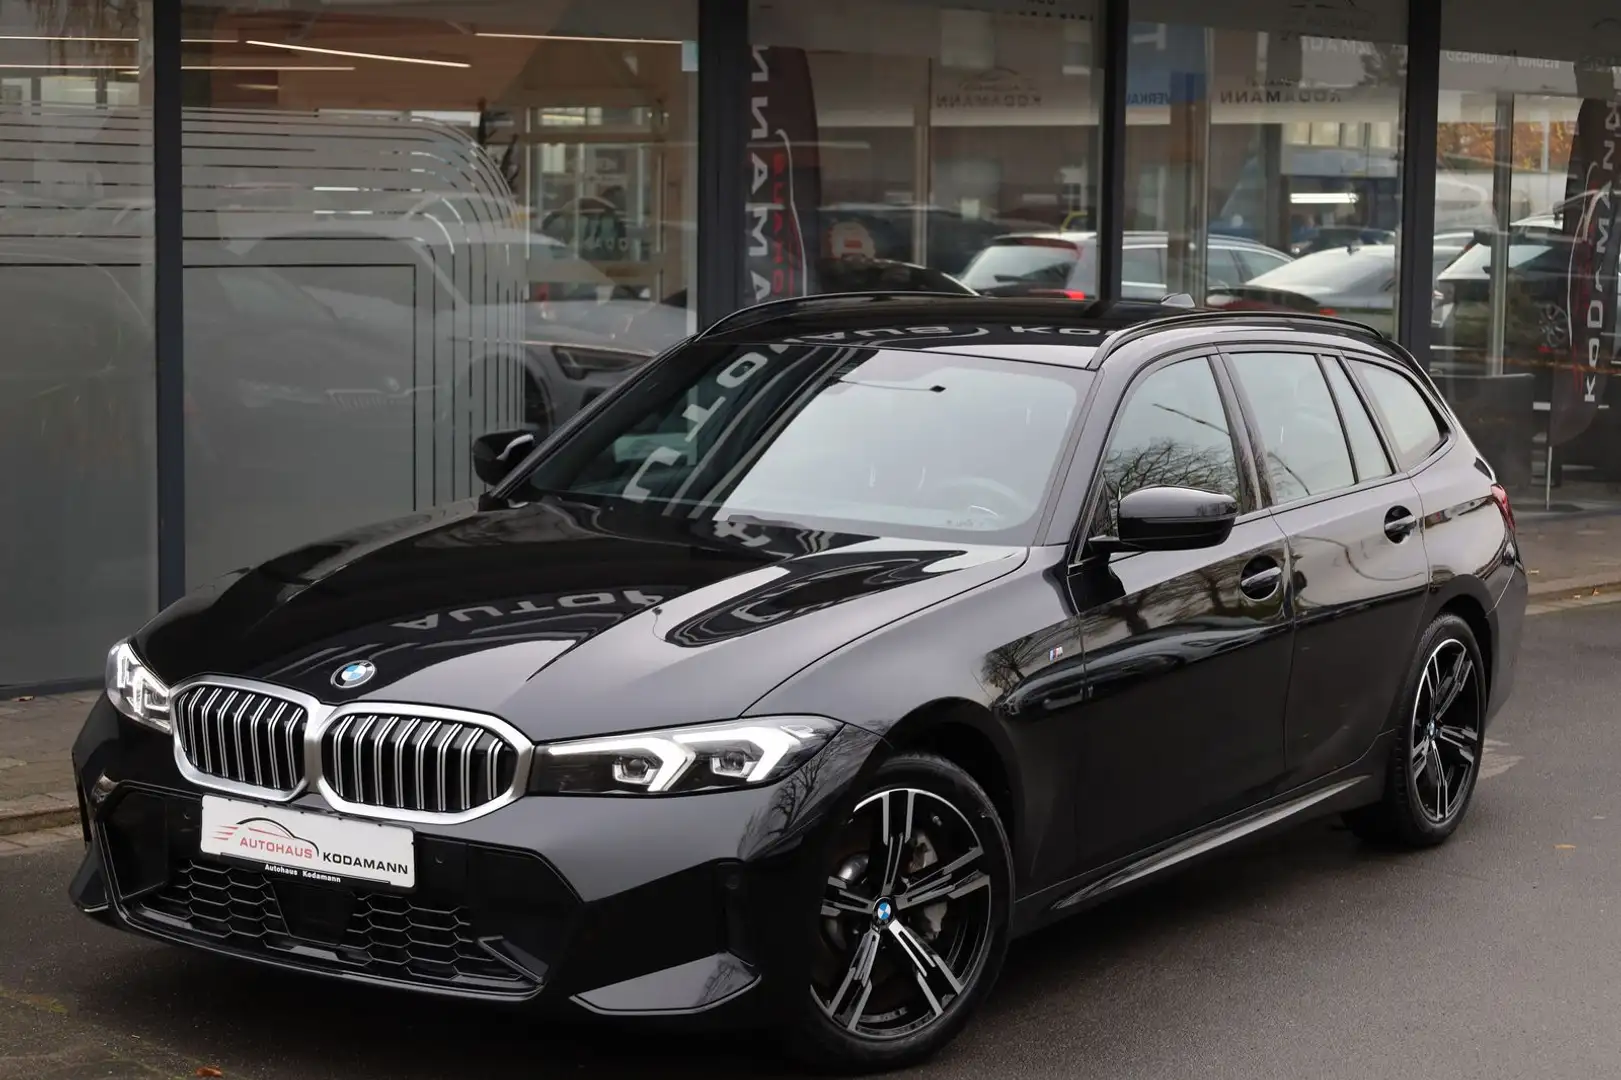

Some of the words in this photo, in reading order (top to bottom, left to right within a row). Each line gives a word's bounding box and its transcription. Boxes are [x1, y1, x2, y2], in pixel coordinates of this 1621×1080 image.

[239, 836, 313, 860] AUTOHAUS
[323, 851, 408, 875] KODAMANN
[264, 863, 298, 876] Autohaus
[302, 869, 341, 883] Kodamann
